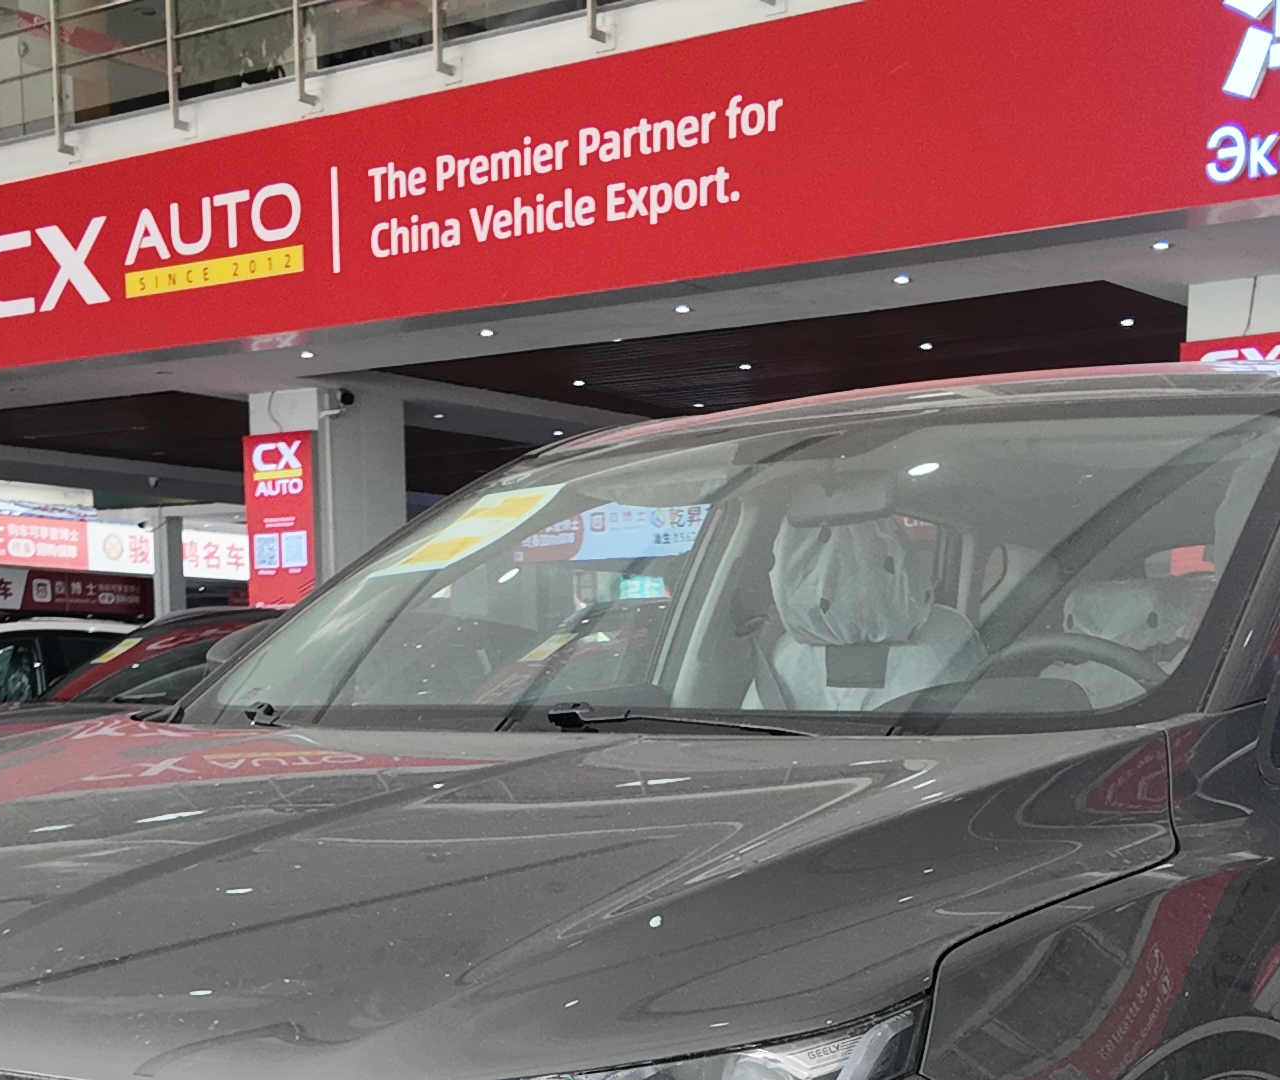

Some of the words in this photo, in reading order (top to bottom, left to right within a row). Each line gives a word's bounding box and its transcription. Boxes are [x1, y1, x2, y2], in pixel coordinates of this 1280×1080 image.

[368, 161, 427, 202] The
[436, 136, 569, 191] Premier
[578, 110, 716, 166] Partner
[725, 94, 783, 139] for
[124, 182, 302, 266] AUTO
[369, 214, 461, 258] China
[469, 188, 596, 243] Vehicle
[606, 165, 741, 225] Export.
[138, 264, 211, 291] SINCE
[232, 253, 293, 277] 2012
[251, 440, 303, 472] CX
[255, 478, 304, 498] AUTO
[807, 1044, 841, 1060] GEELY
